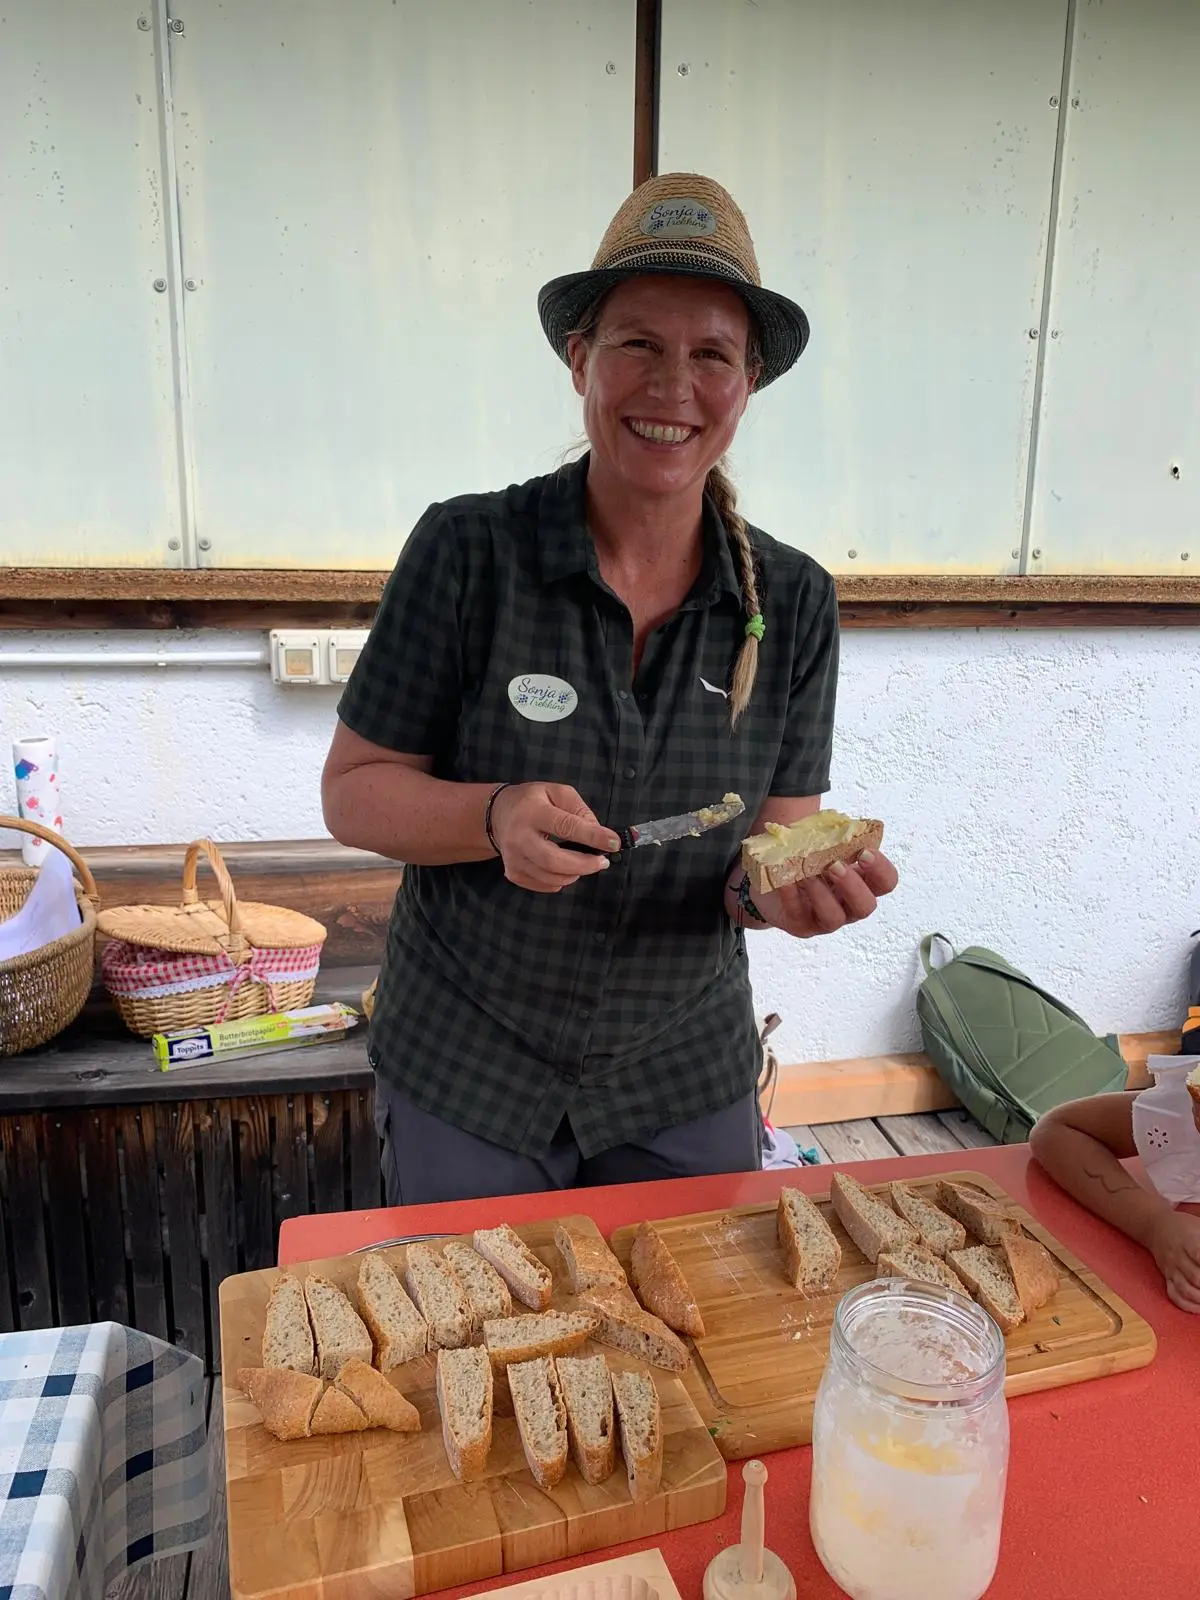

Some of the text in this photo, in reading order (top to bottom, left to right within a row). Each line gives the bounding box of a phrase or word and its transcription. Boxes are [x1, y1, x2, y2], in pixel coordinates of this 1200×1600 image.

[650, 205, 695, 220] Sonja
[666, 216, 707, 230] Trekking
[517, 677, 557, 701] Sonja
[529, 695, 566, 713] Trekking
[219, 1026, 276, 1041] Butterbrotpapier
[177, 1043, 204, 1054] Toppits
